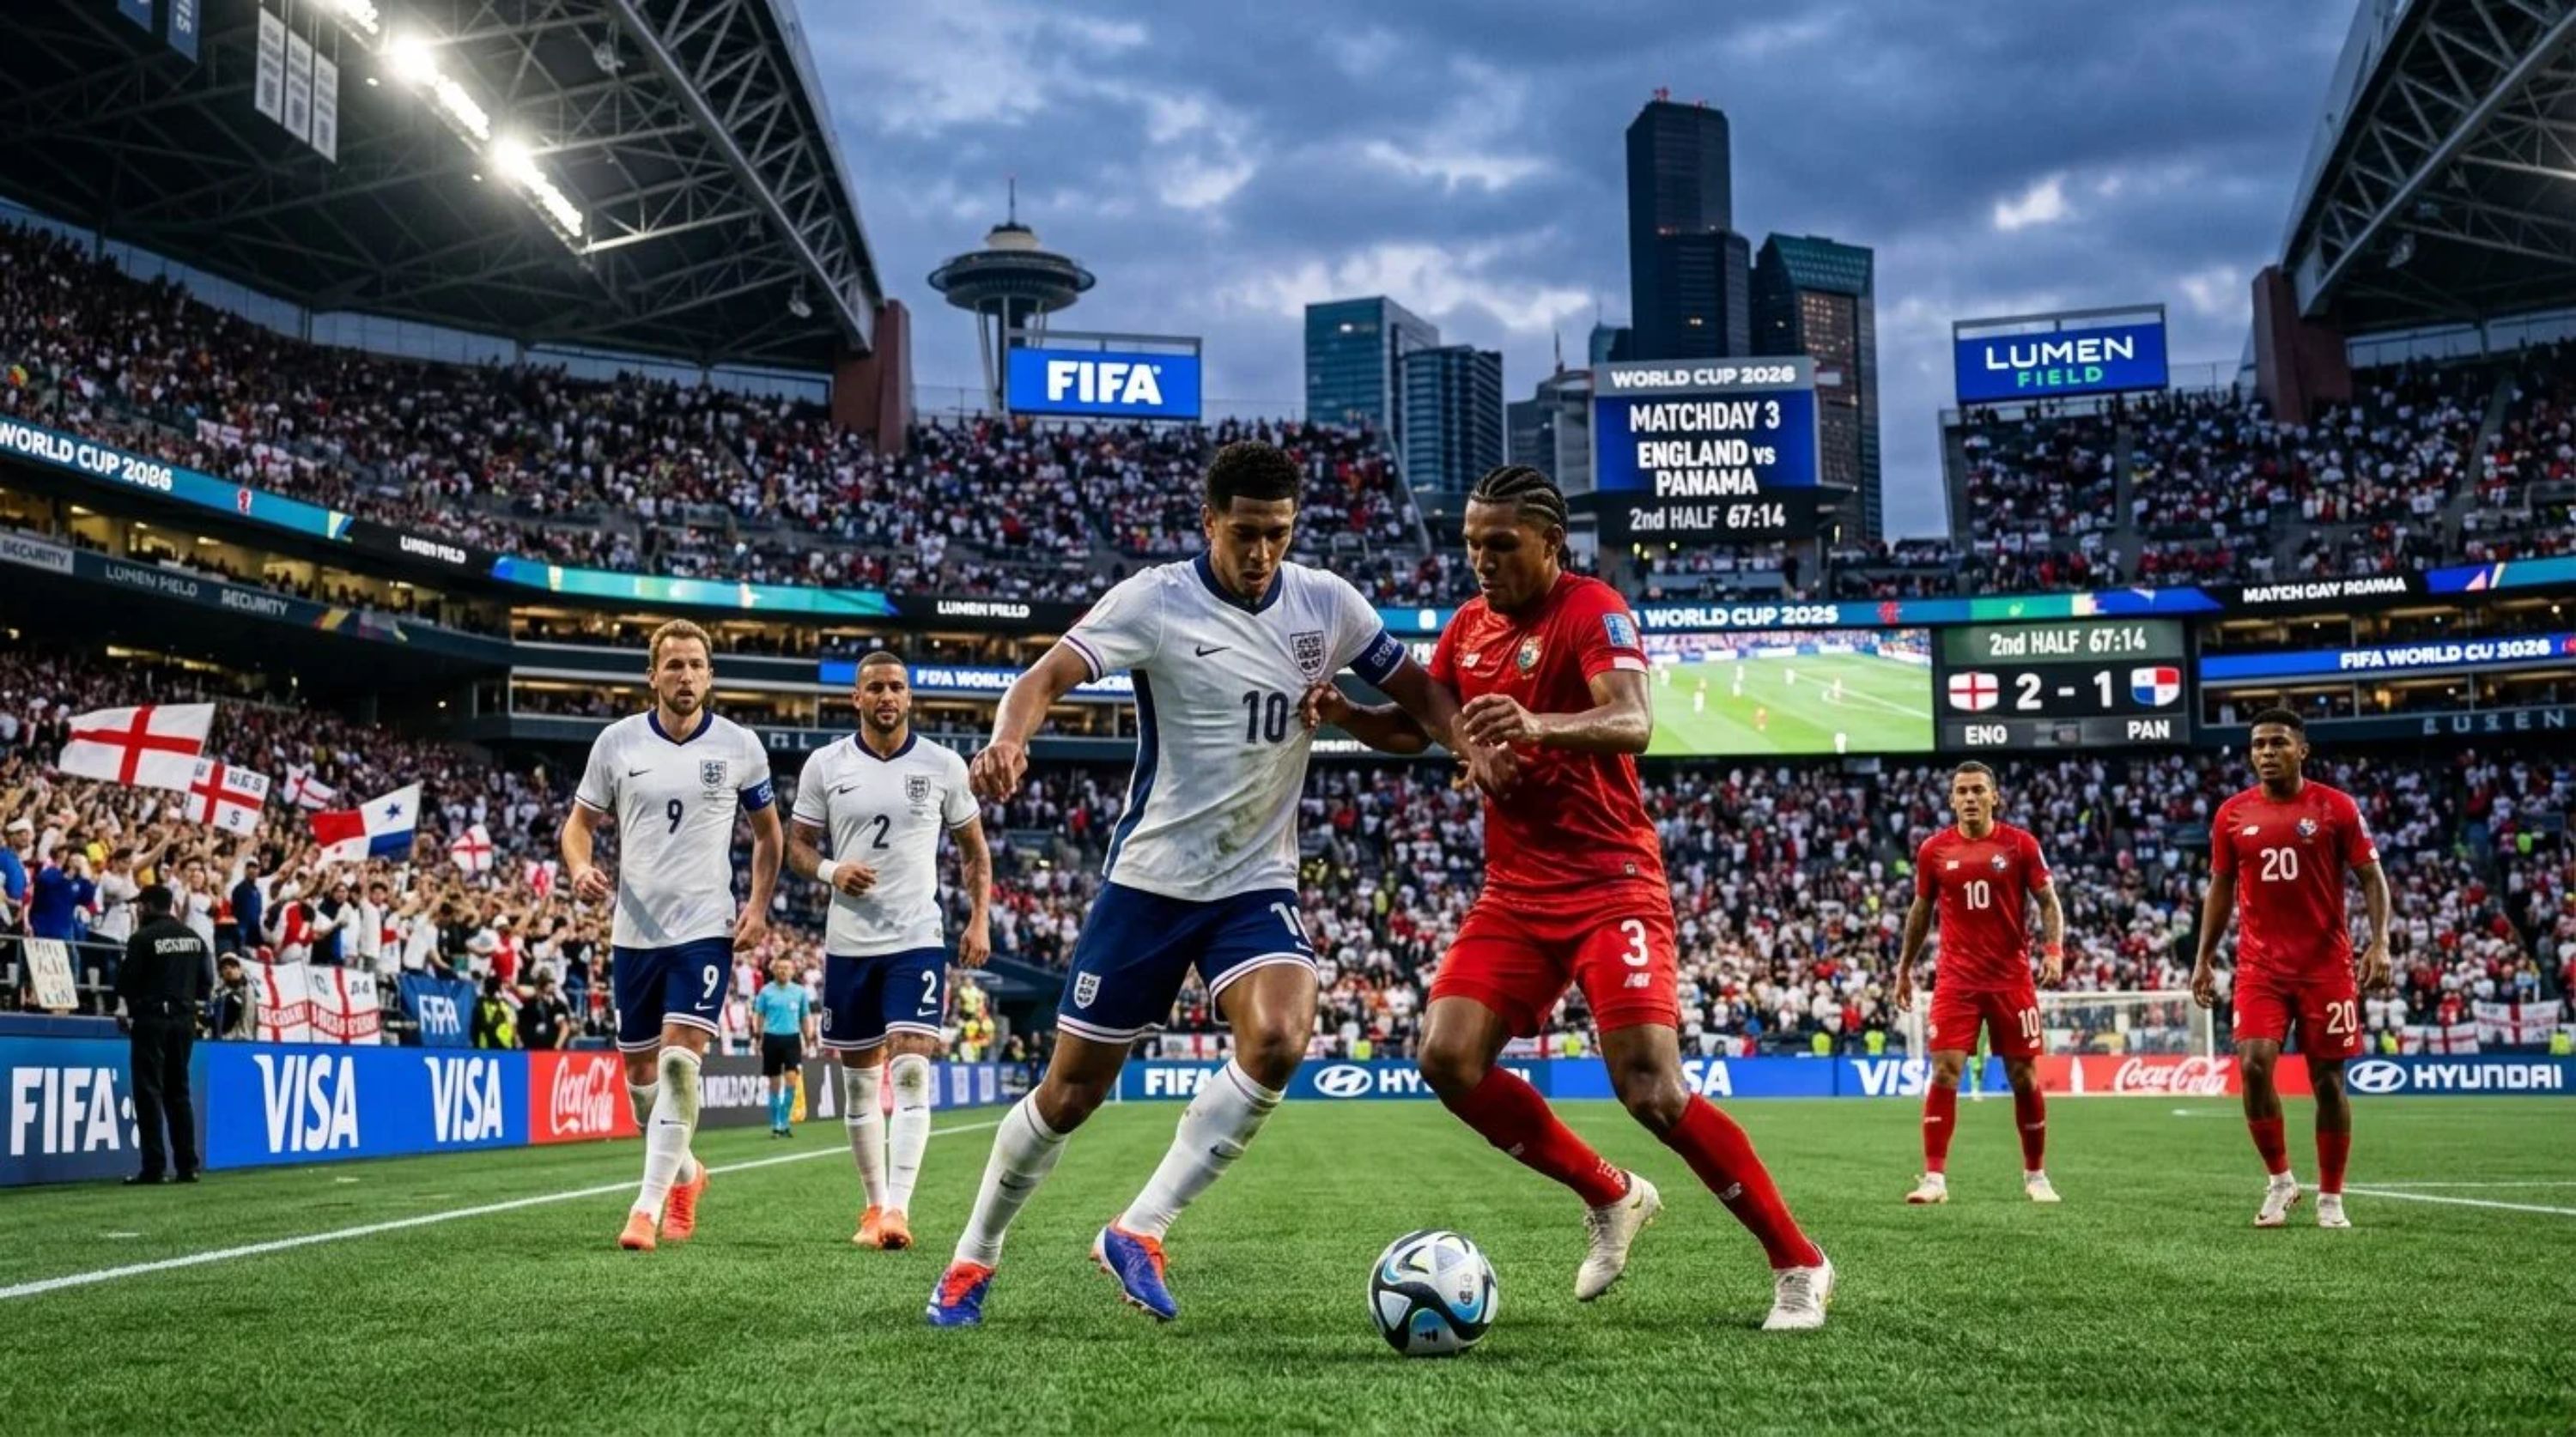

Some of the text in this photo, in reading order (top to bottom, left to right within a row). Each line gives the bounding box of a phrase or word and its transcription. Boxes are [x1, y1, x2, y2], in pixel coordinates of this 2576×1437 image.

[1986, 336, 2134, 371] LUMEN
[1048, 360, 1163, 404] FIFA
[1612, 366, 1796, 389] WORLD CUP 2026
[2018, 366, 2104, 387] FIELD
[1630, 400, 1782, 433] MATCHDAY 3
[0, 422, 74, 464] WORLD
[77, 444, 120, 475] CUP
[1637, 440, 1777, 469] ENGLAND vs
[1656, 468, 1759, 497] PANAMA
[1630, 503, 1786, 531] 2nd HALF 67:14
[1646, 607, 1728, 628] WORLD
[1731, 606, 1777, 626] CUP
[1990, 628, 2147, 655] 2nd HALF 67:14
[2340, 651, 2385, 669] FIFA
[2386, 645, 2462, 666] WORLD
[2015, 672, 2042, 710] 2
[2093, 671, 2111, 708] 1
[1242, 688, 1288, 744] 10
[1965, 720, 2171, 745] ENG PAN
[667, 798, 683, 834] 9
[872, 814, 890, 850] 2
[2260, 847, 2299, 882] 20
[1964, 880, 1990, 910] 10
[1620, 918, 1649, 967] 3
[702, 964, 720, 998] 9
[921, 970, 938, 1004] 2
[2018, 1004, 2040, 1038] 10
[2326, 999, 2358, 1035] 20
[2414, 1064, 2563, 1090] HYUNDAI
[10, 1066, 120, 1156] FIFA
[253, 1054, 359, 1155] VISA
[425, 1057, 504, 1143] VISA
